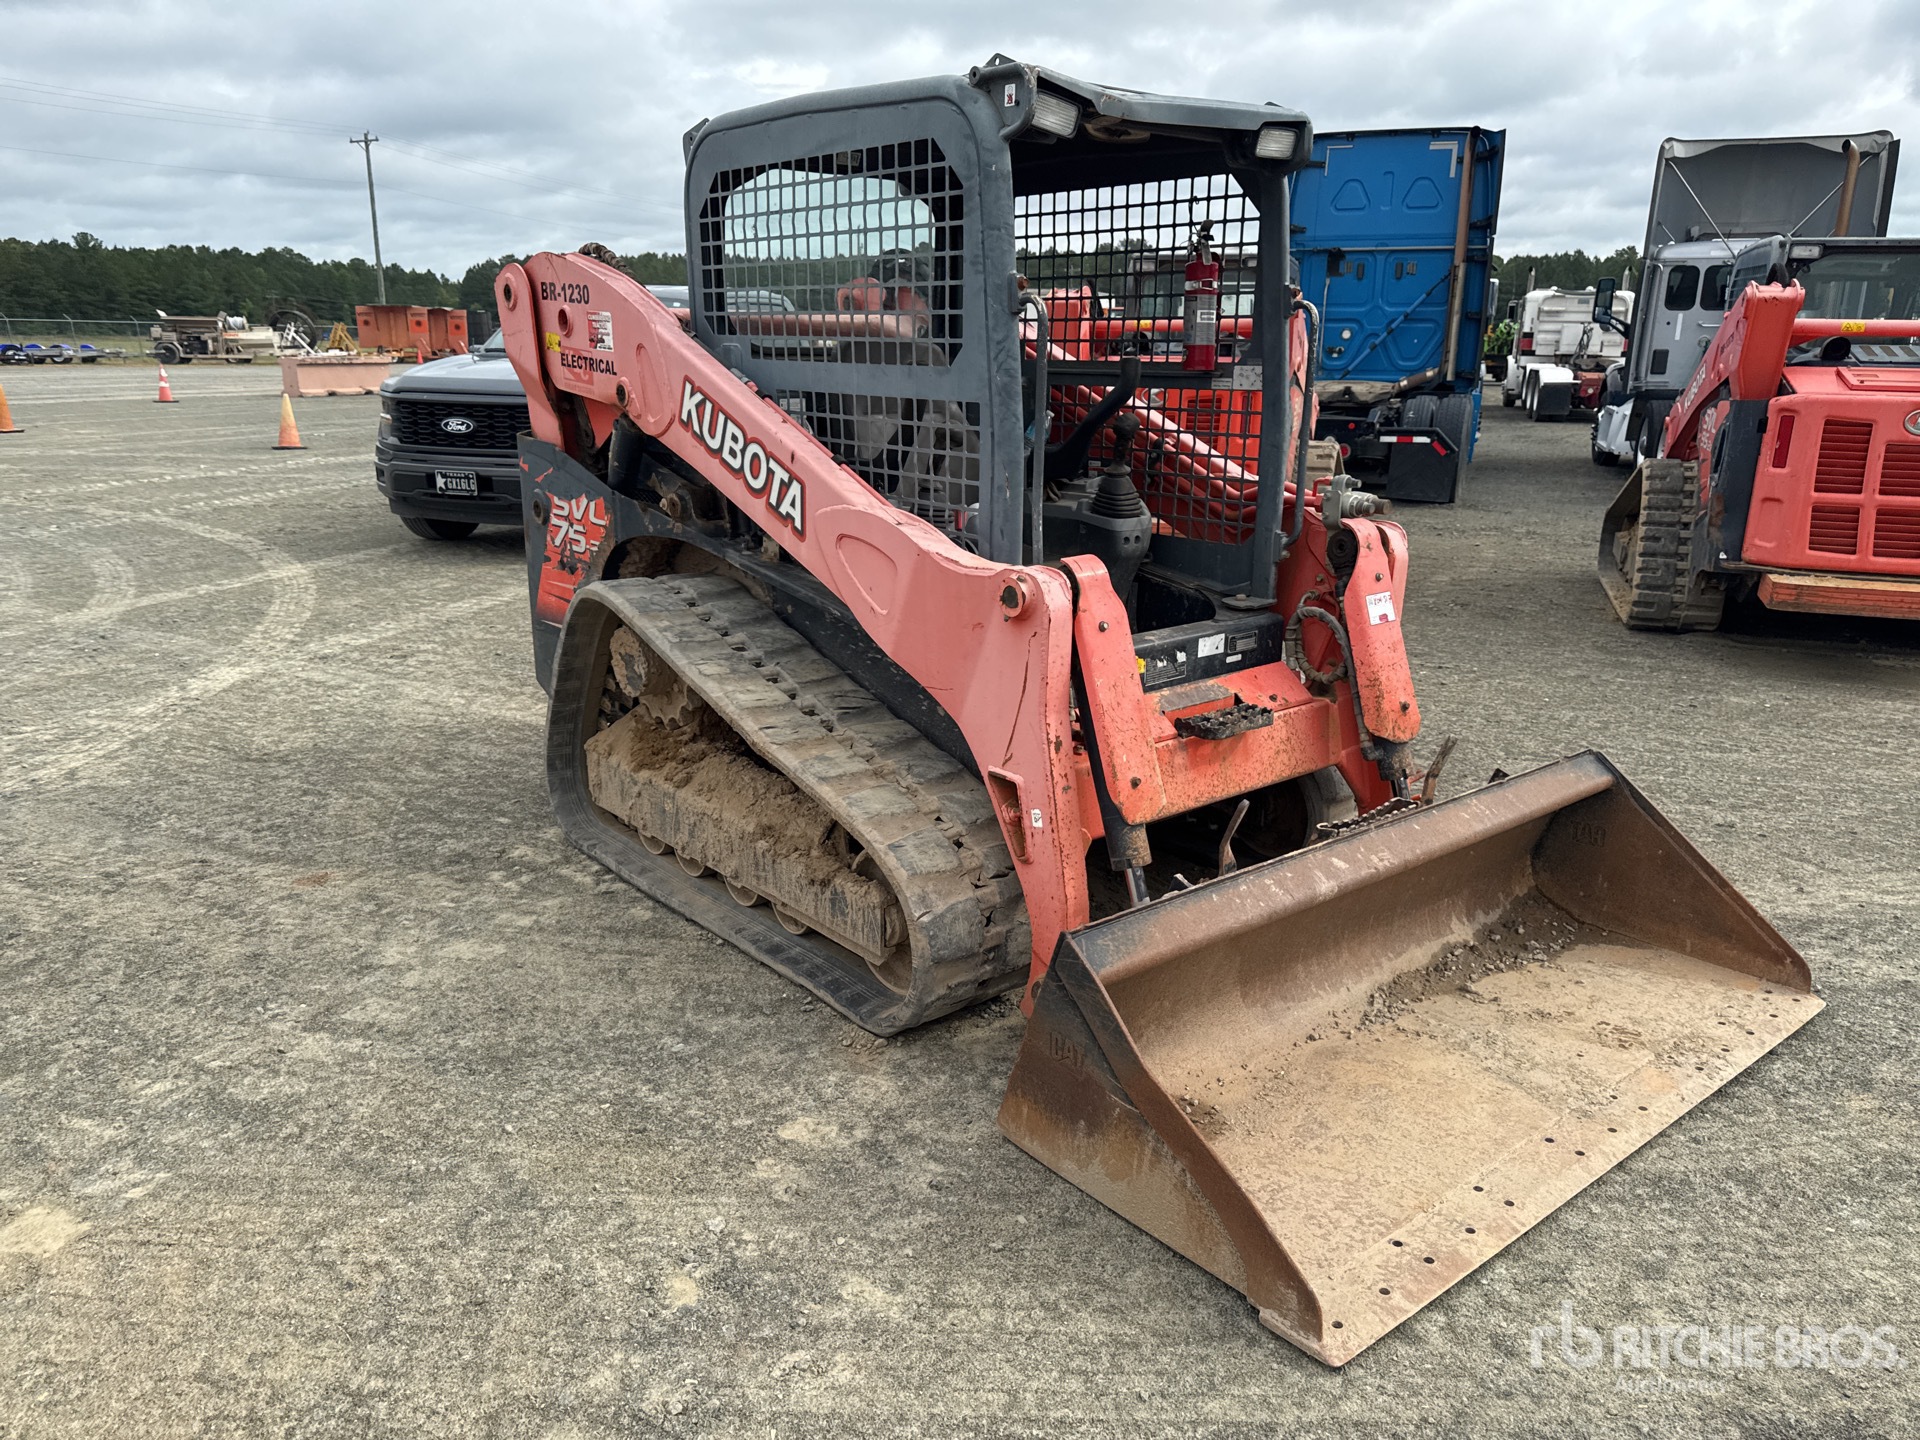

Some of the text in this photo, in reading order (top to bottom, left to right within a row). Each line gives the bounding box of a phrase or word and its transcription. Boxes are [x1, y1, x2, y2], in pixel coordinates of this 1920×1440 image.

[540, 282, 590, 305] BR-1230
[560, 352, 617, 376] ELECTRICAL
[446, 420, 468, 431] Ford
[680, 379, 803, 533] KUBOTA
[551, 496, 606, 526] SVL
[1050, 1031, 1086, 1072] CAT
